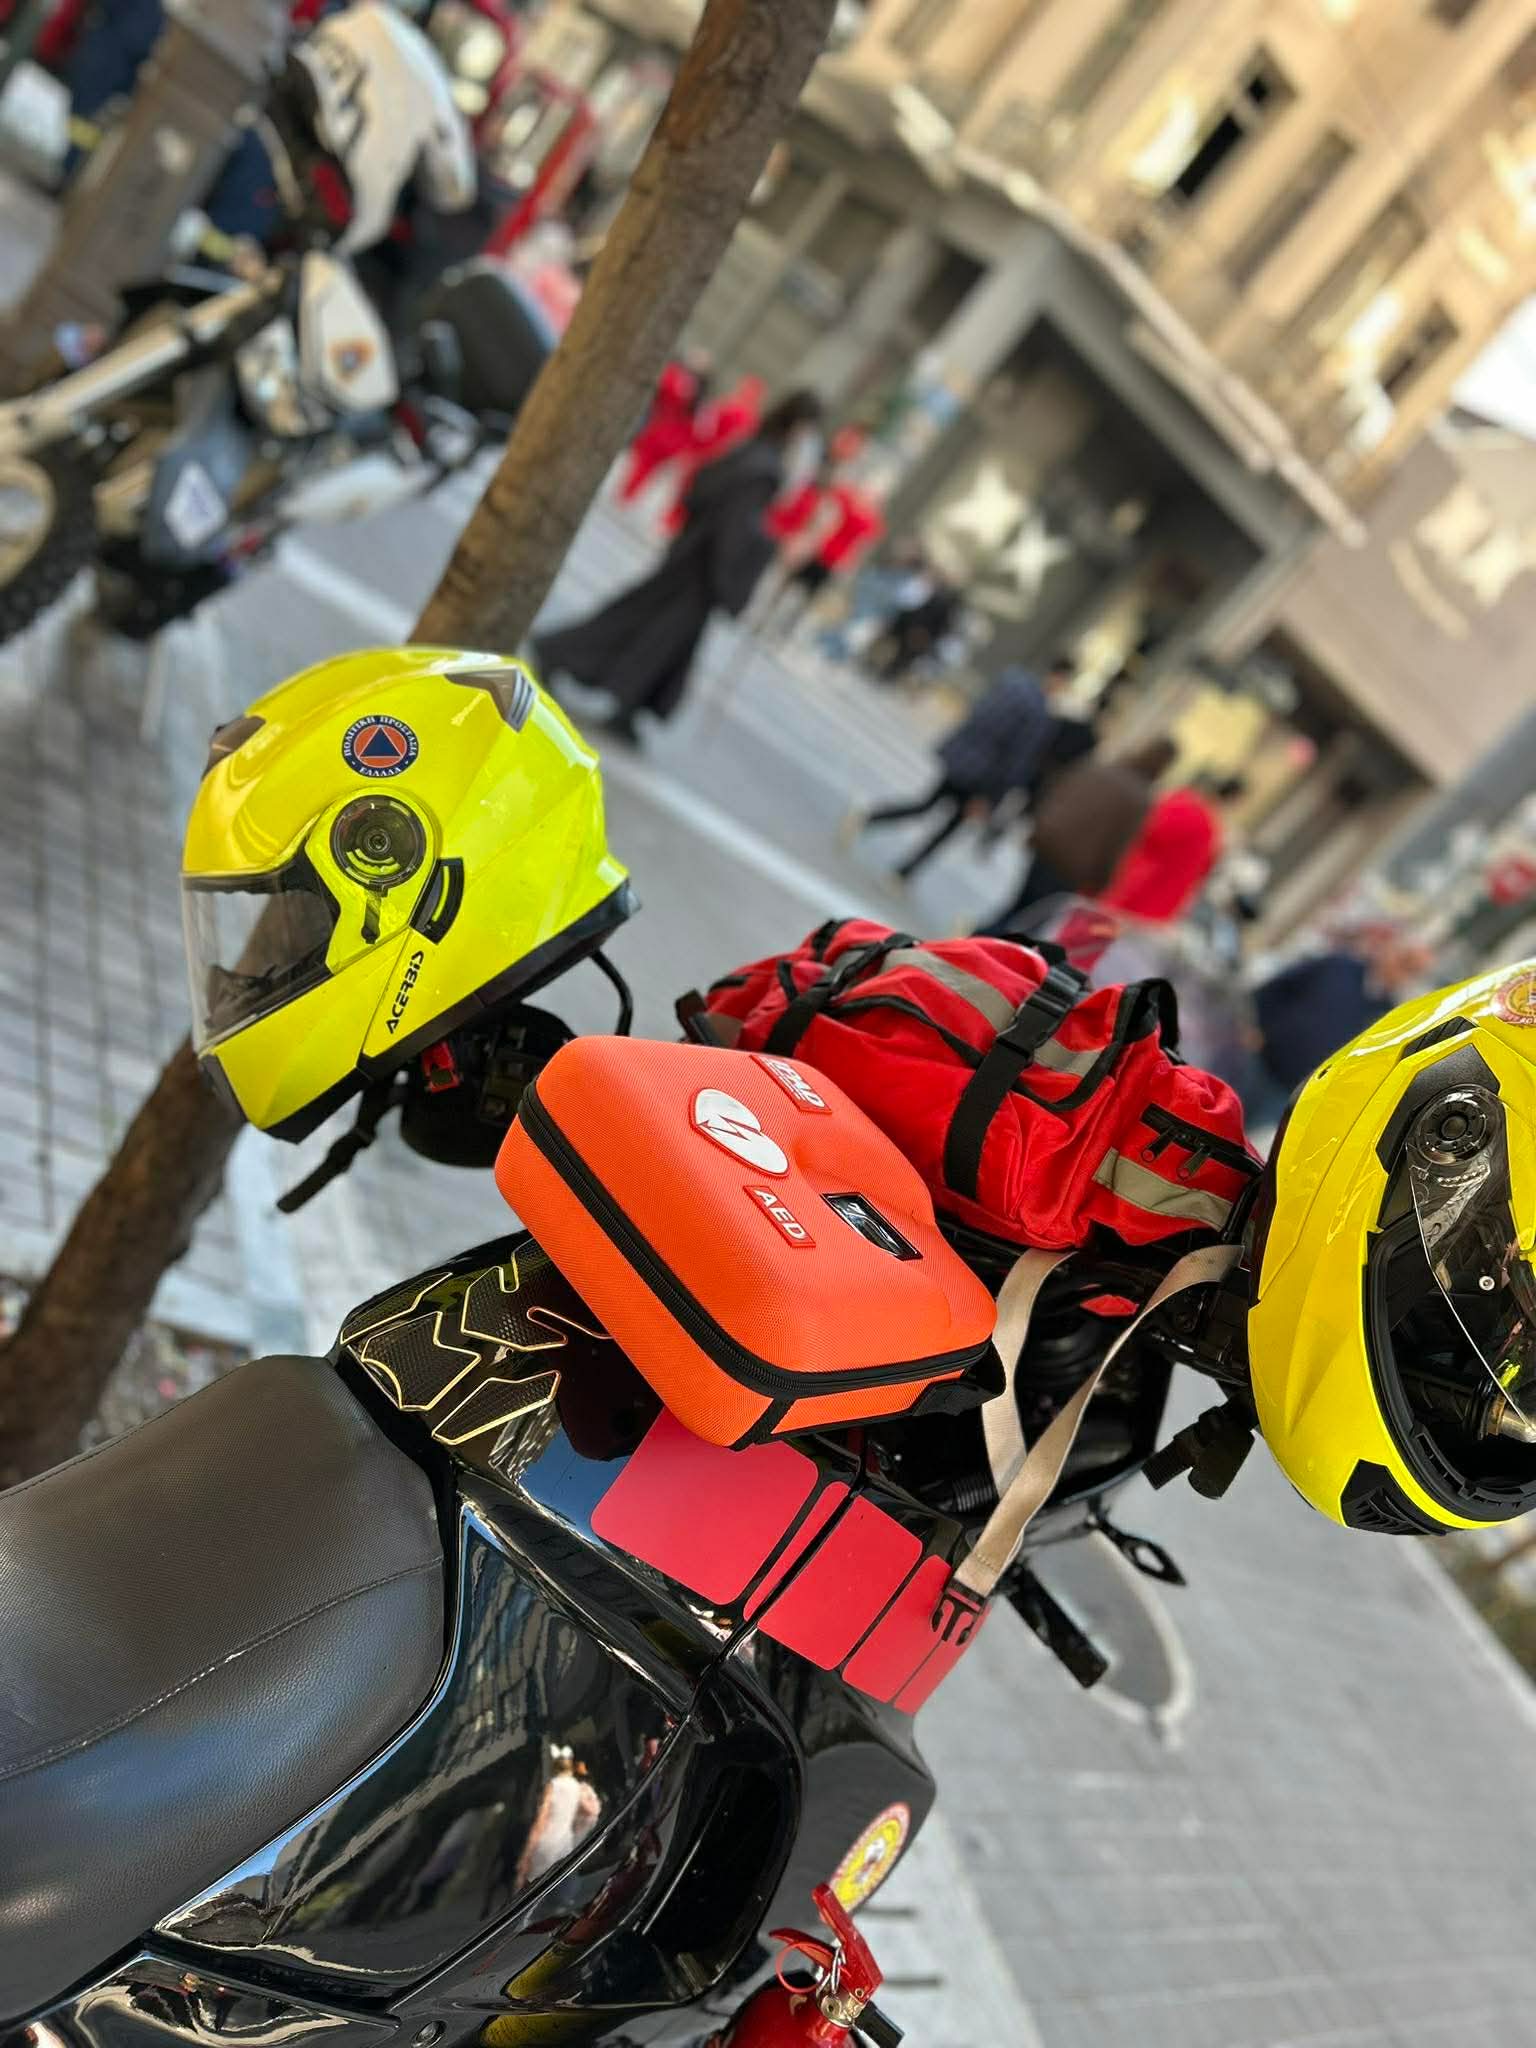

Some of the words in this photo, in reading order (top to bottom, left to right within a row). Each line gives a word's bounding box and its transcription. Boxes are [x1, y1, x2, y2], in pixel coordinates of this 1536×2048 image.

[344, 715, 376, 757] ΠΟΛΙΤΙΚΗ
[379, 715, 417, 757] ΠΡΟΣΤΑΣΙΑ
[359, 767, 402, 777] ΕΛΛΑΔΑ
[753, 1189, 807, 1239] AED
